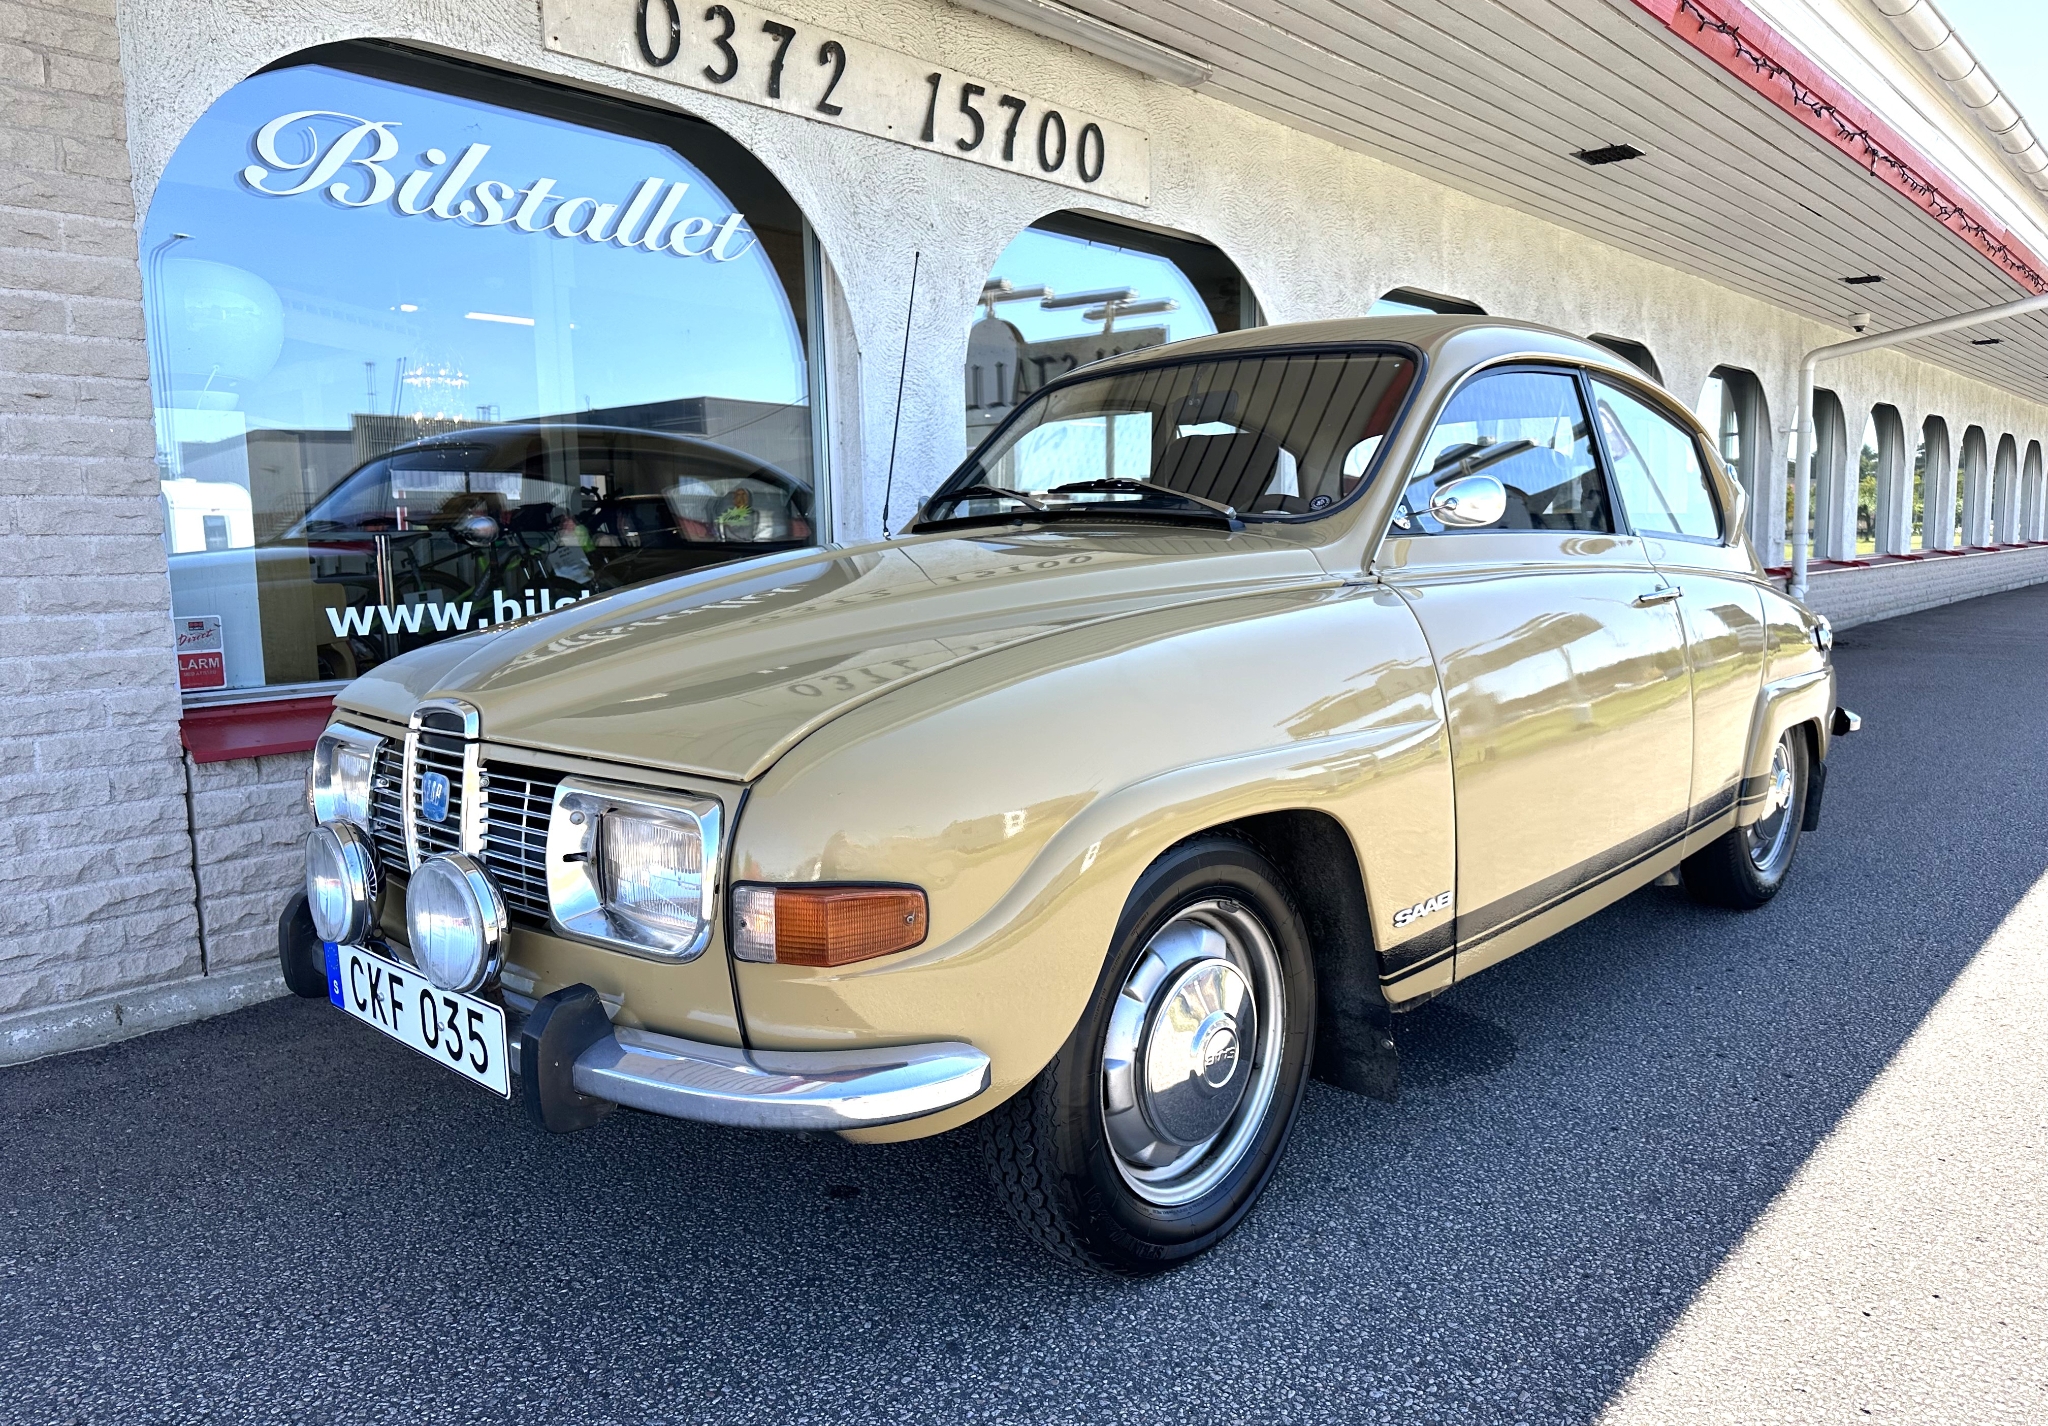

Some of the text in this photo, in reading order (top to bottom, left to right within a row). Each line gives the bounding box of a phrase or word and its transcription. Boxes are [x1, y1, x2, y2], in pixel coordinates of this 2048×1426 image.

[636, 0, 1104, 183] 0372 15700
[243, 110, 757, 262] Bilstallet
[325, 588, 590, 638] www.bil
[179, 658, 220, 671] LARM
[1393, 891, 1453, 928] SAAB
[332, 979, 340, 994] S
[350, 955, 489, 1074] CKF 035
